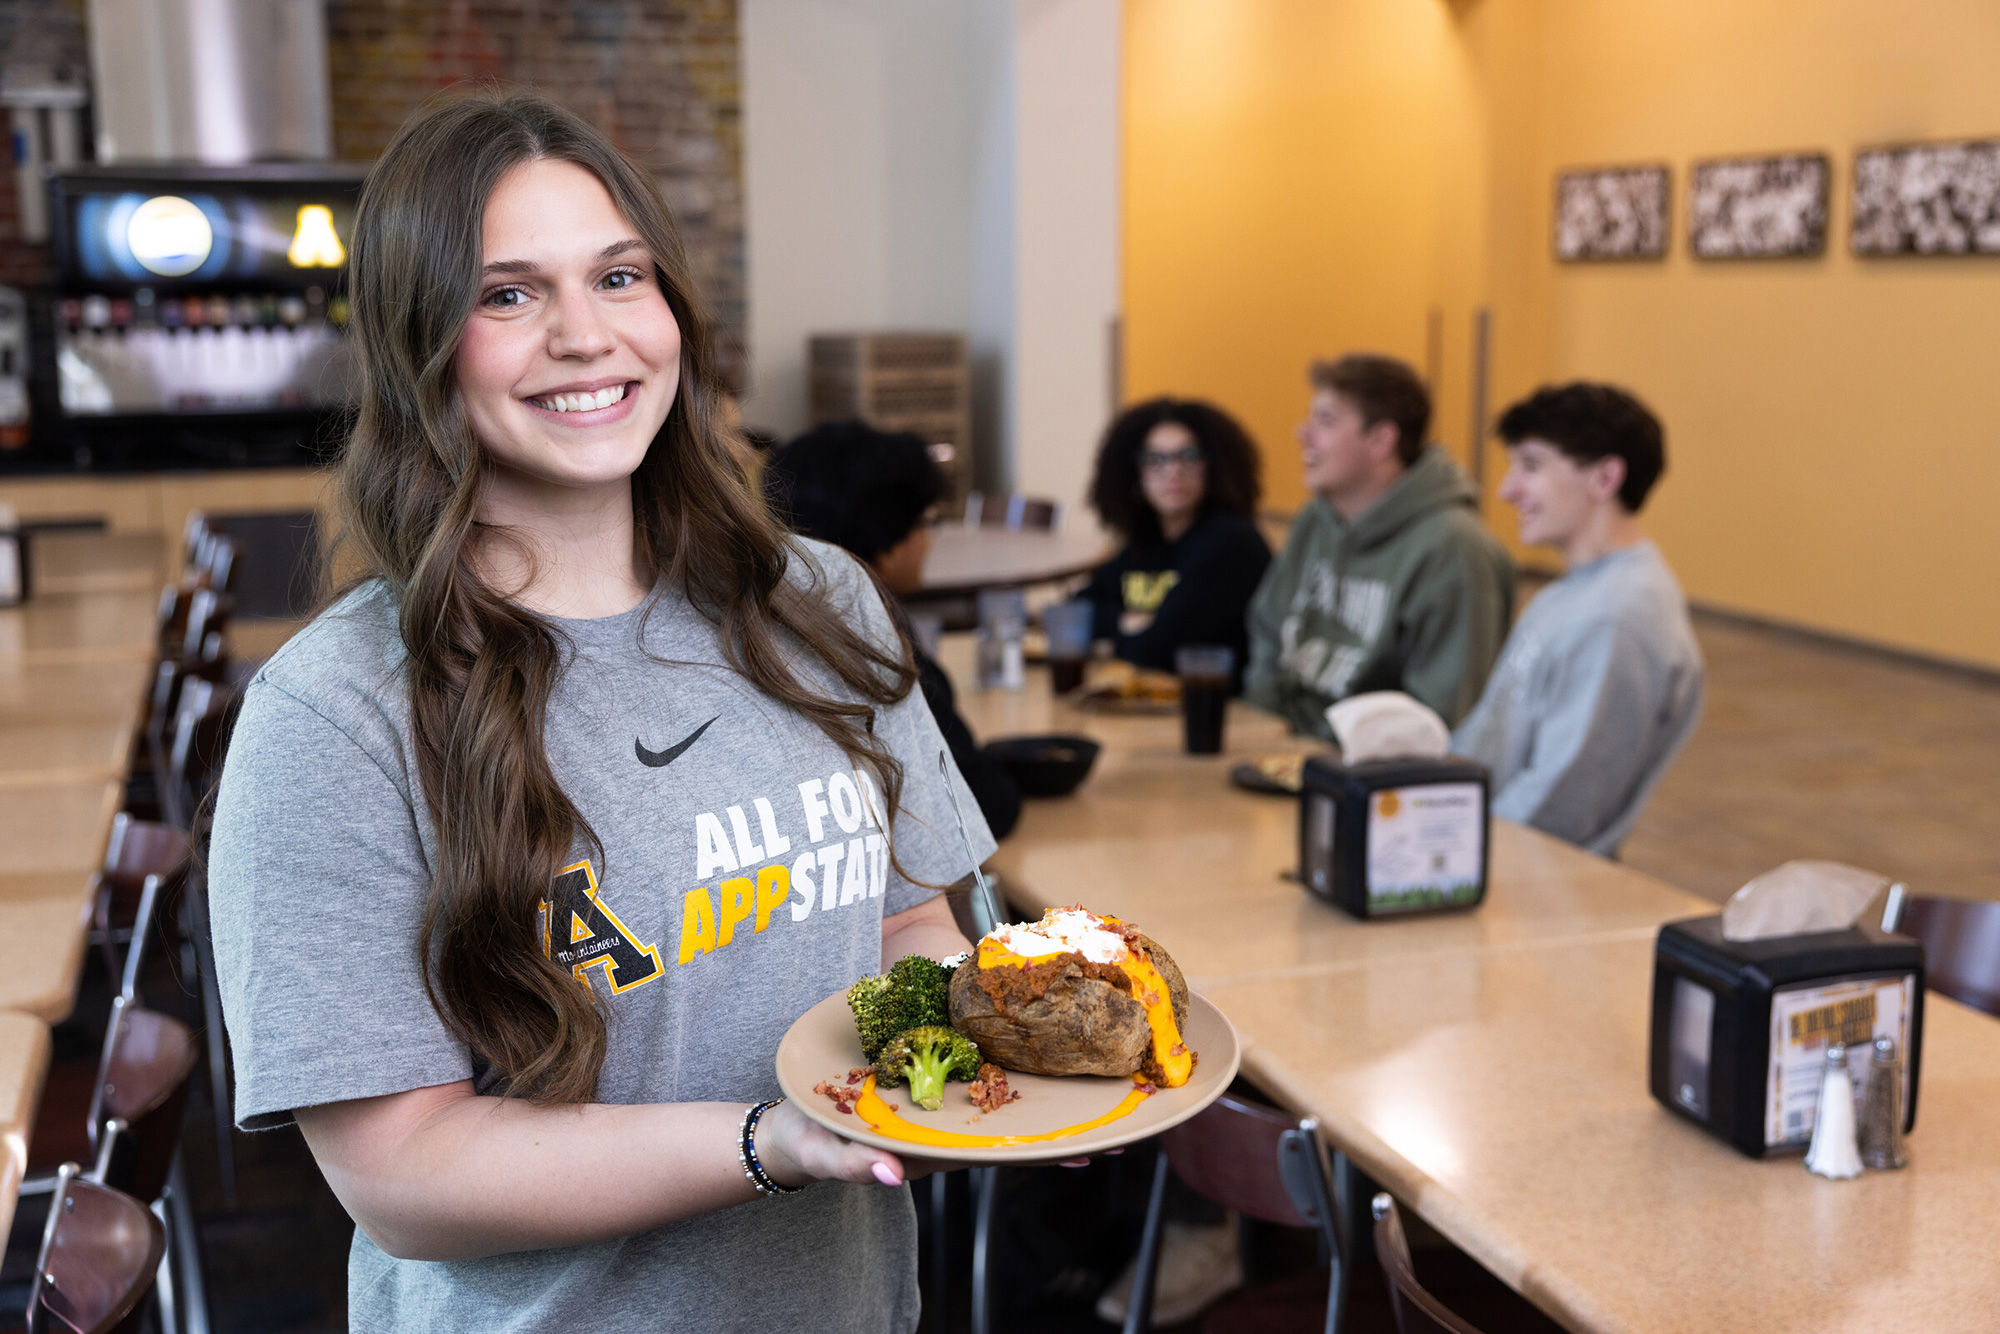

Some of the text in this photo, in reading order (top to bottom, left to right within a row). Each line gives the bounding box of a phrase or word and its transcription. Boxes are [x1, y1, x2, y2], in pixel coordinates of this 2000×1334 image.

[695, 769, 883, 880] ALL FOR
[538, 859, 666, 1004] A
